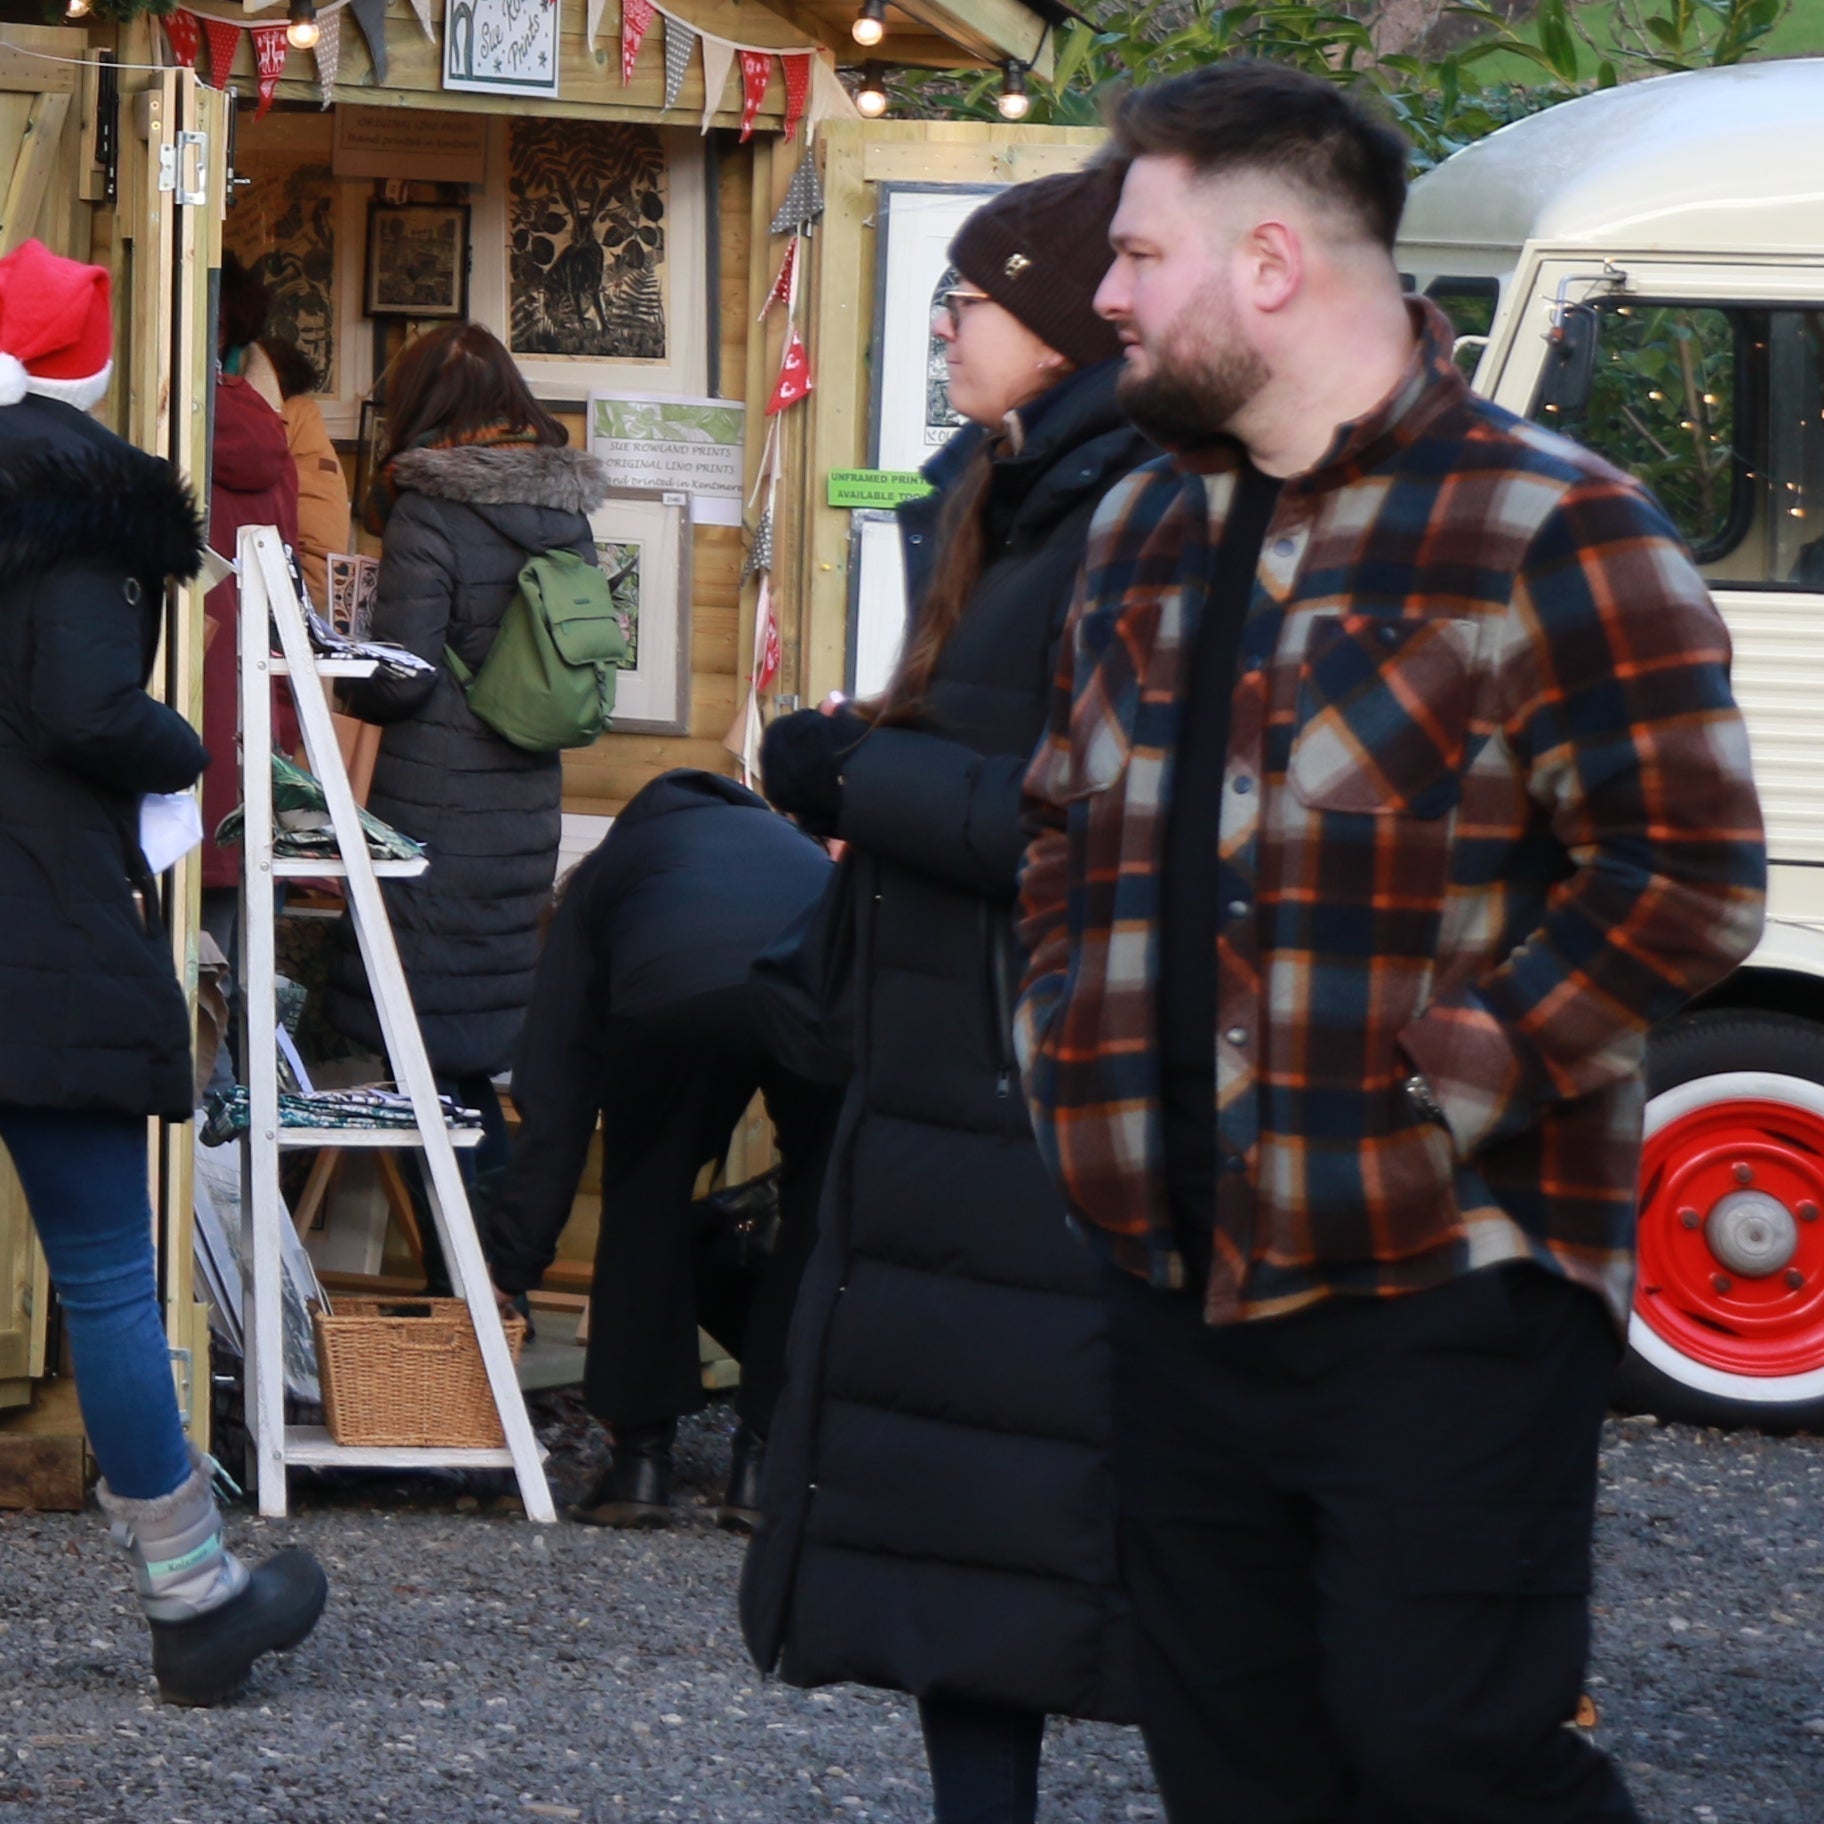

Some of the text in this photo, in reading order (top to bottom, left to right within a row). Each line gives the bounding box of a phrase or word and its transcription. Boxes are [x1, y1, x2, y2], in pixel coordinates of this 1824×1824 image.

[480, 22, 503, 60] Sue
[507, 13, 541, 72] Prints
[609, 441, 732, 458] SUE ROWLAND PRINTS
[605, 458, 736, 475] ORIGINAL LINO PRINTS
[608, 475, 628, 485] and
[631, 479, 673, 488] printed
[676, 480, 690, 488] in
[831, 472, 889, 484] UNFRAMED
[837, 490, 895, 501] AVAILABLE
